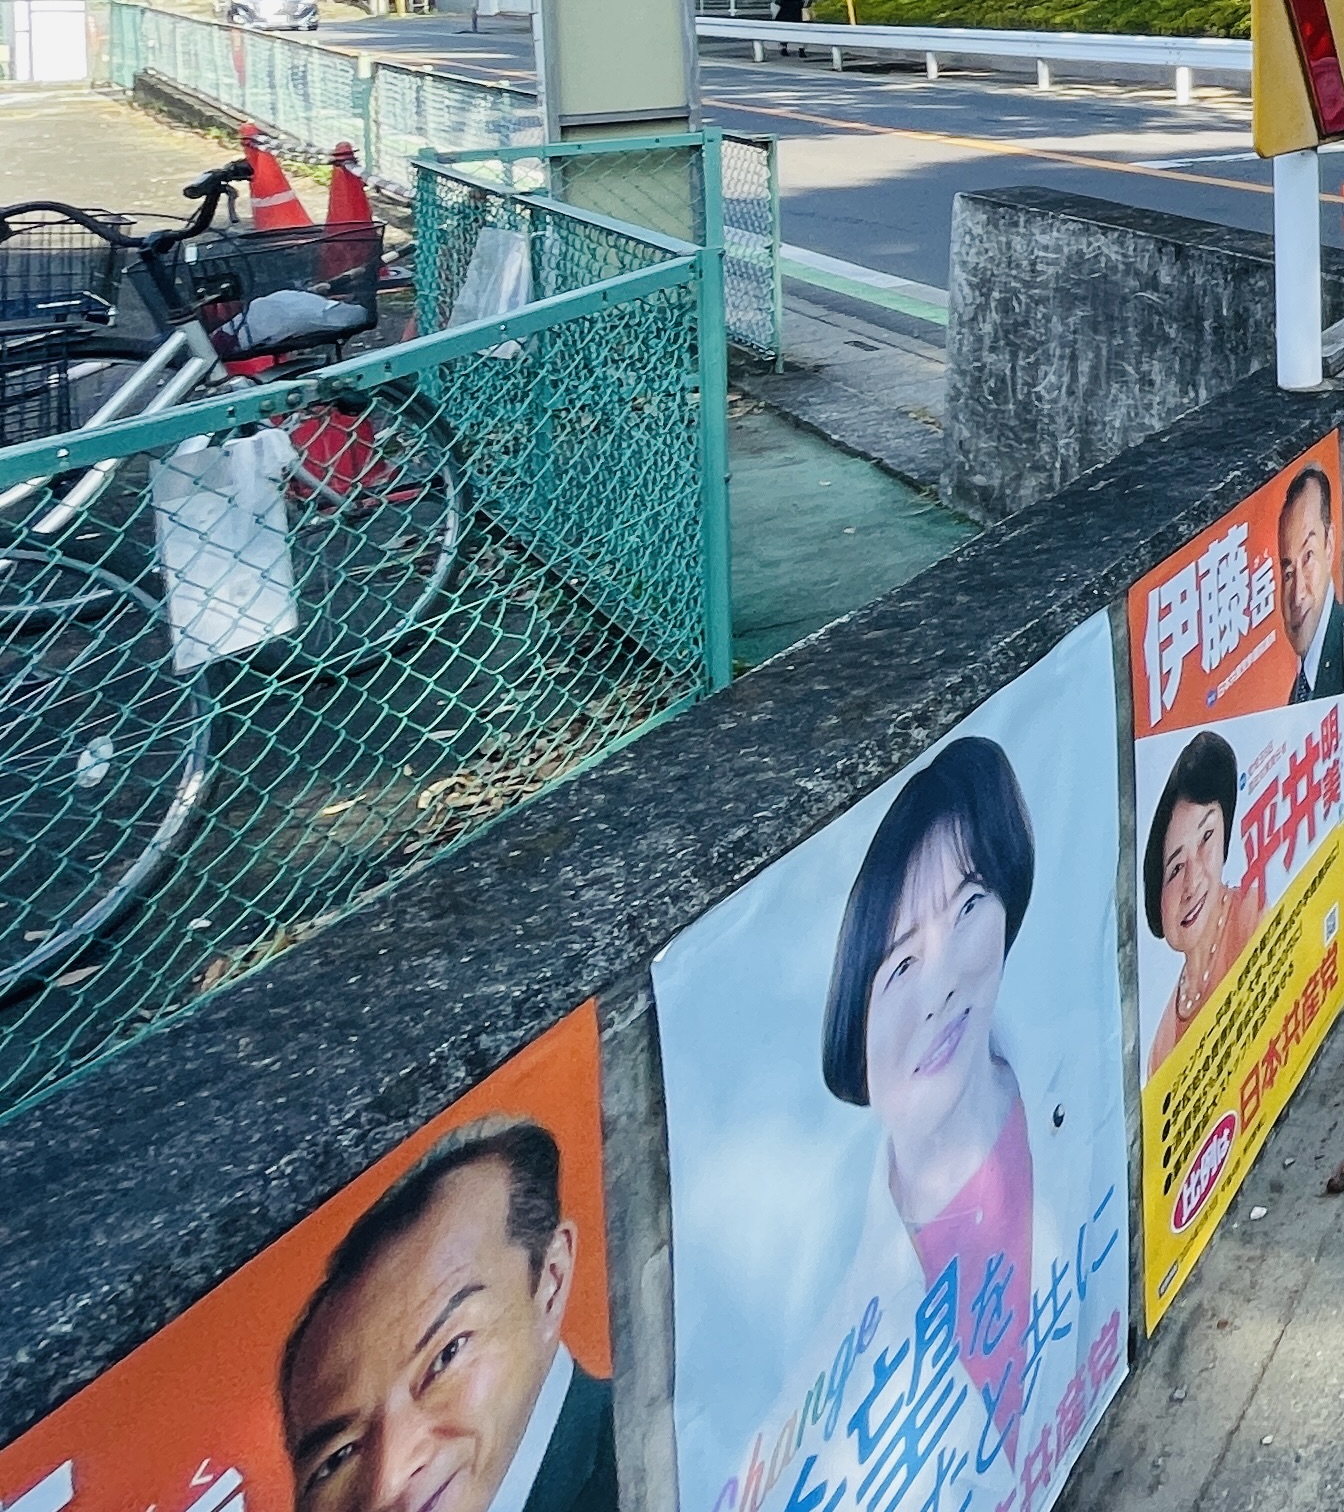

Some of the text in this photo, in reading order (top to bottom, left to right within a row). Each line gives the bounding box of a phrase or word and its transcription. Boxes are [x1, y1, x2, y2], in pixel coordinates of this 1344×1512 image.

[1240, 940, 1339, 1136] 日本共産党
